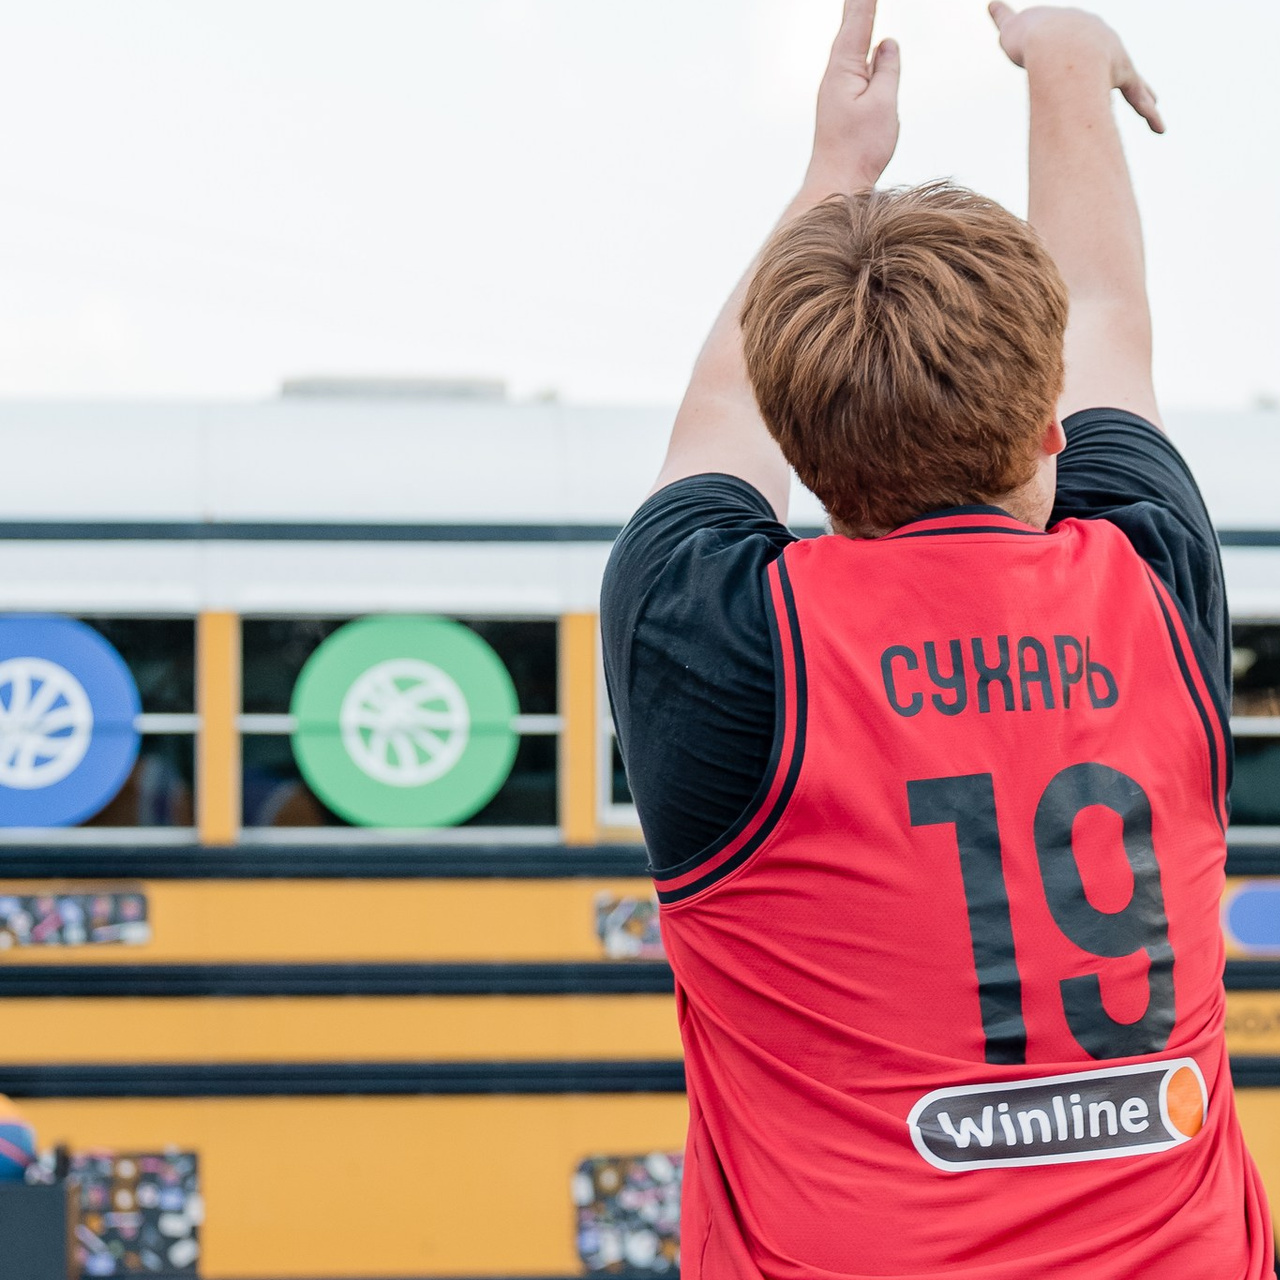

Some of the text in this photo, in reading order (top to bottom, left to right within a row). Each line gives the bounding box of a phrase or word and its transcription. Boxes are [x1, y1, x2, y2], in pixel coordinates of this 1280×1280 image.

[880, 634, 1119, 717] СУХАРЬ
[906, 762, 1176, 1065] 19
[938, 1093, 1150, 1148] Winline
